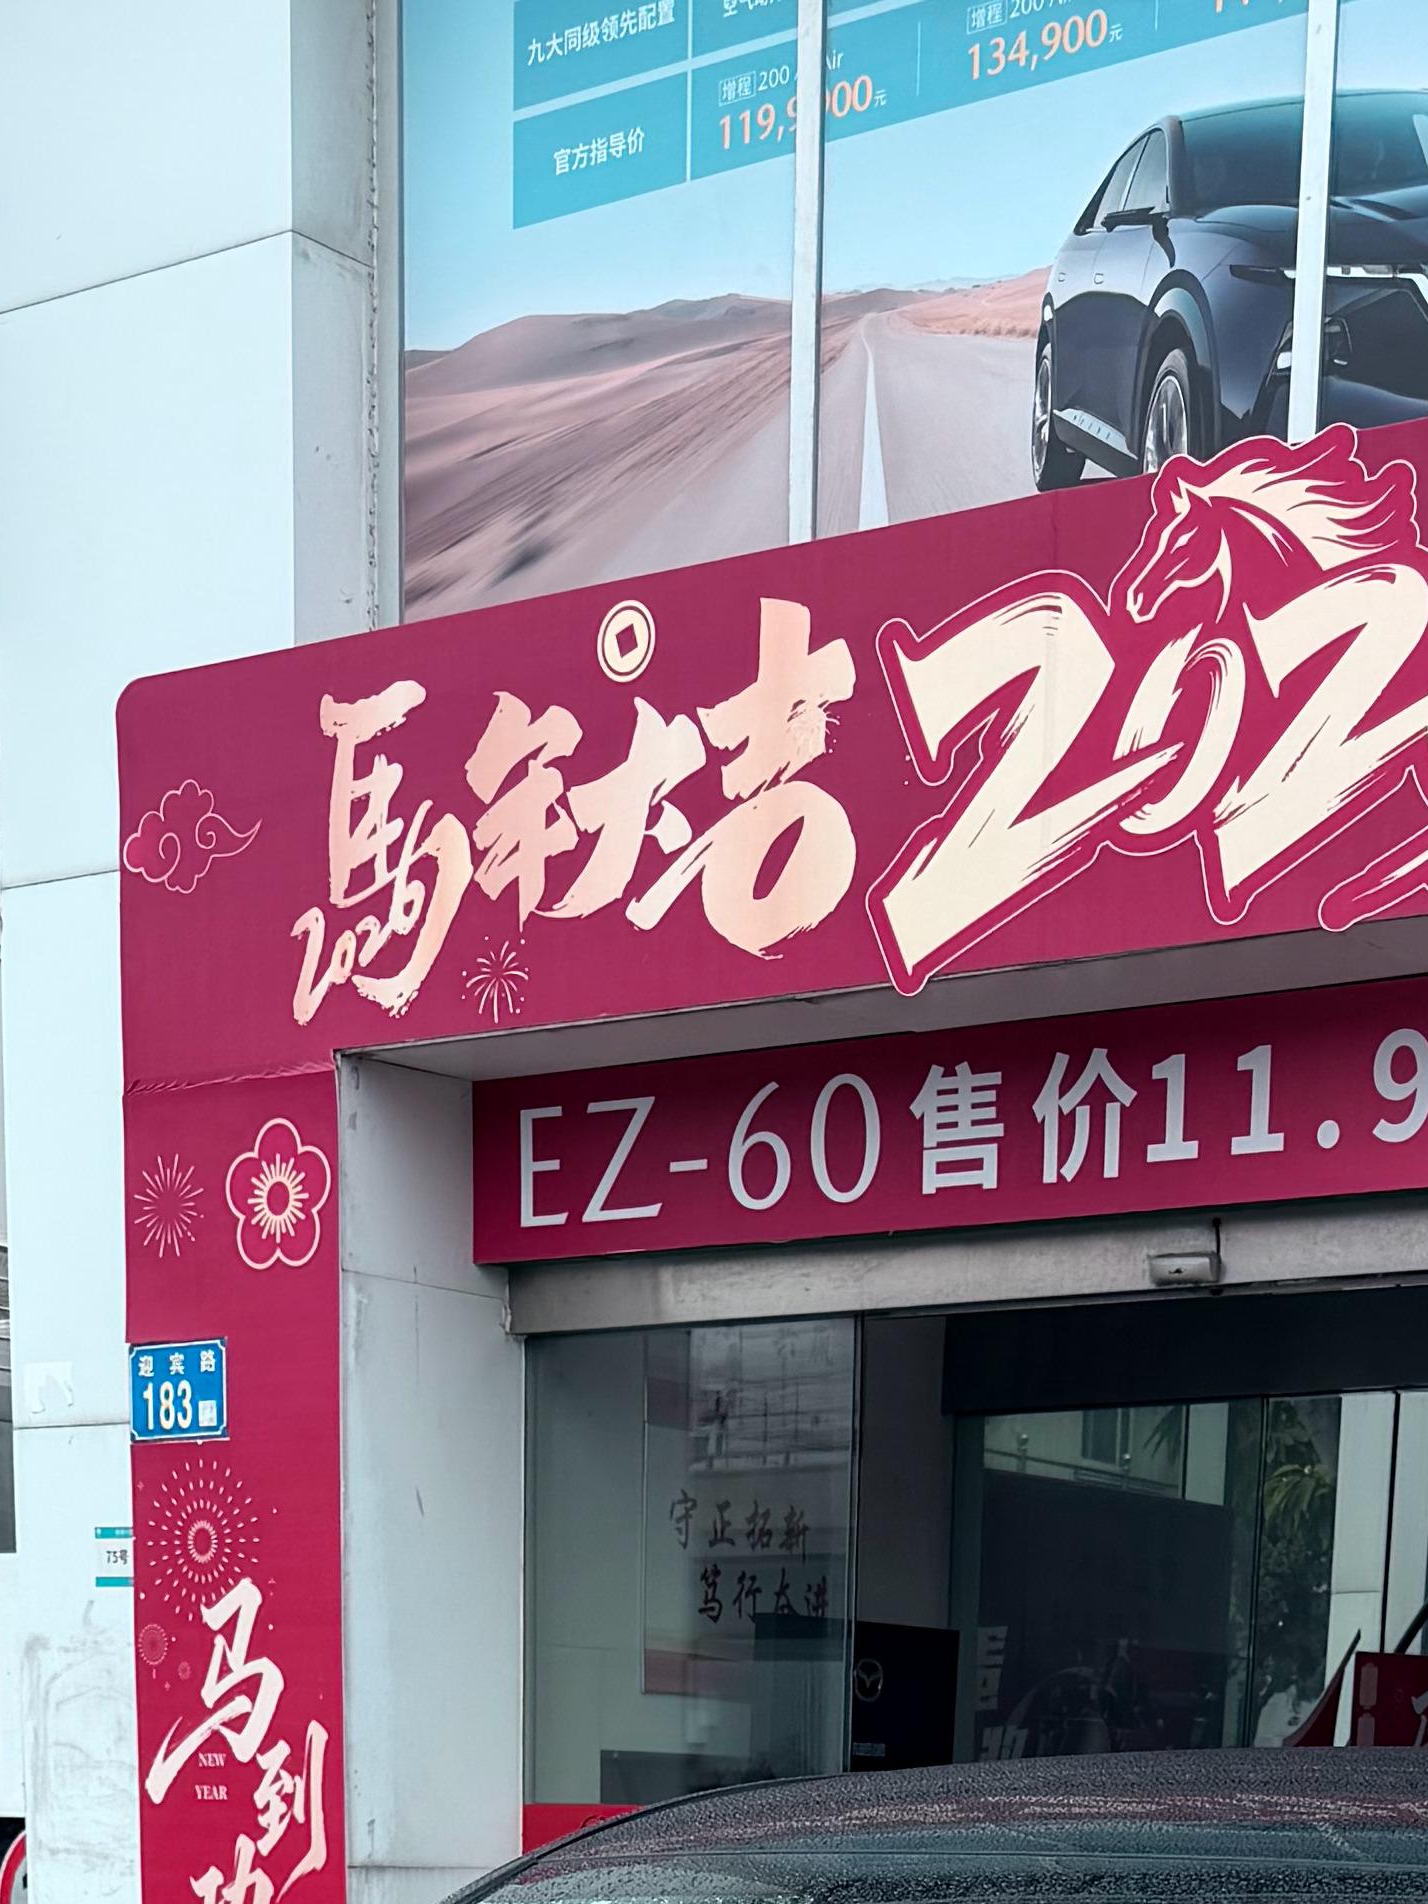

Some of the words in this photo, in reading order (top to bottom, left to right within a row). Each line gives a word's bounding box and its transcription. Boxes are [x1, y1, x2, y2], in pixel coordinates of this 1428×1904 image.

[527, 0, 675, 66] 九大同级领先配置
[722, 76, 752, 102] 增程
[758, 65, 790, 91] 200
[553, 126, 645, 176] 官方指导价
[142, 1379, 193, 1430] 183
[198, 1752, 227, 1768] NEW
[194, 1784, 228, 1801] YEAR
